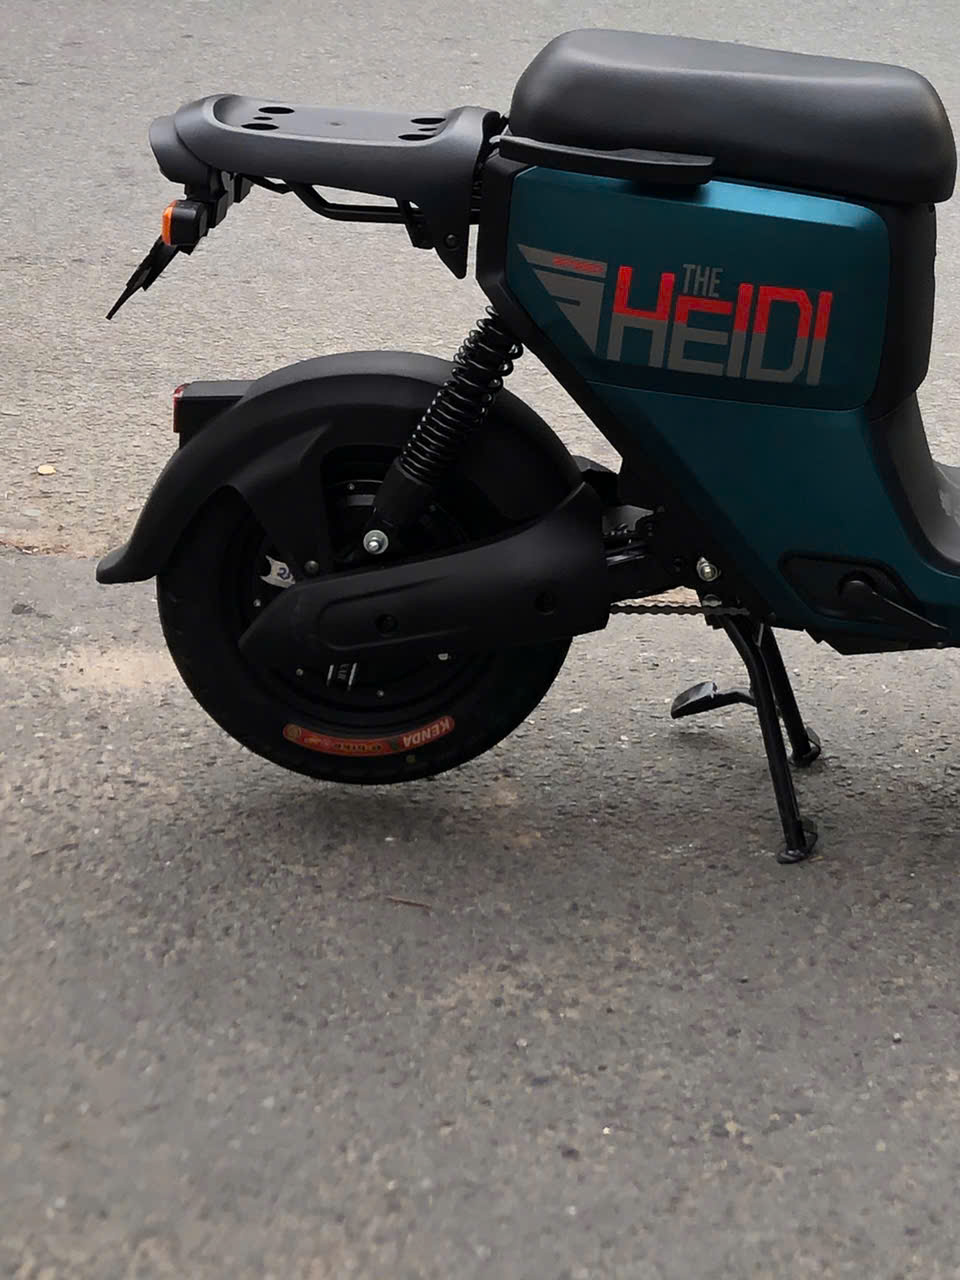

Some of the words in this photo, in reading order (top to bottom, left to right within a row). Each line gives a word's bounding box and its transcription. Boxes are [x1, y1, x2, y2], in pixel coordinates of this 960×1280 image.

[682, 263, 724, 298] THE
[606, 266, 833, 386] HEIDI
[403, 718, 450, 747] KENDA
